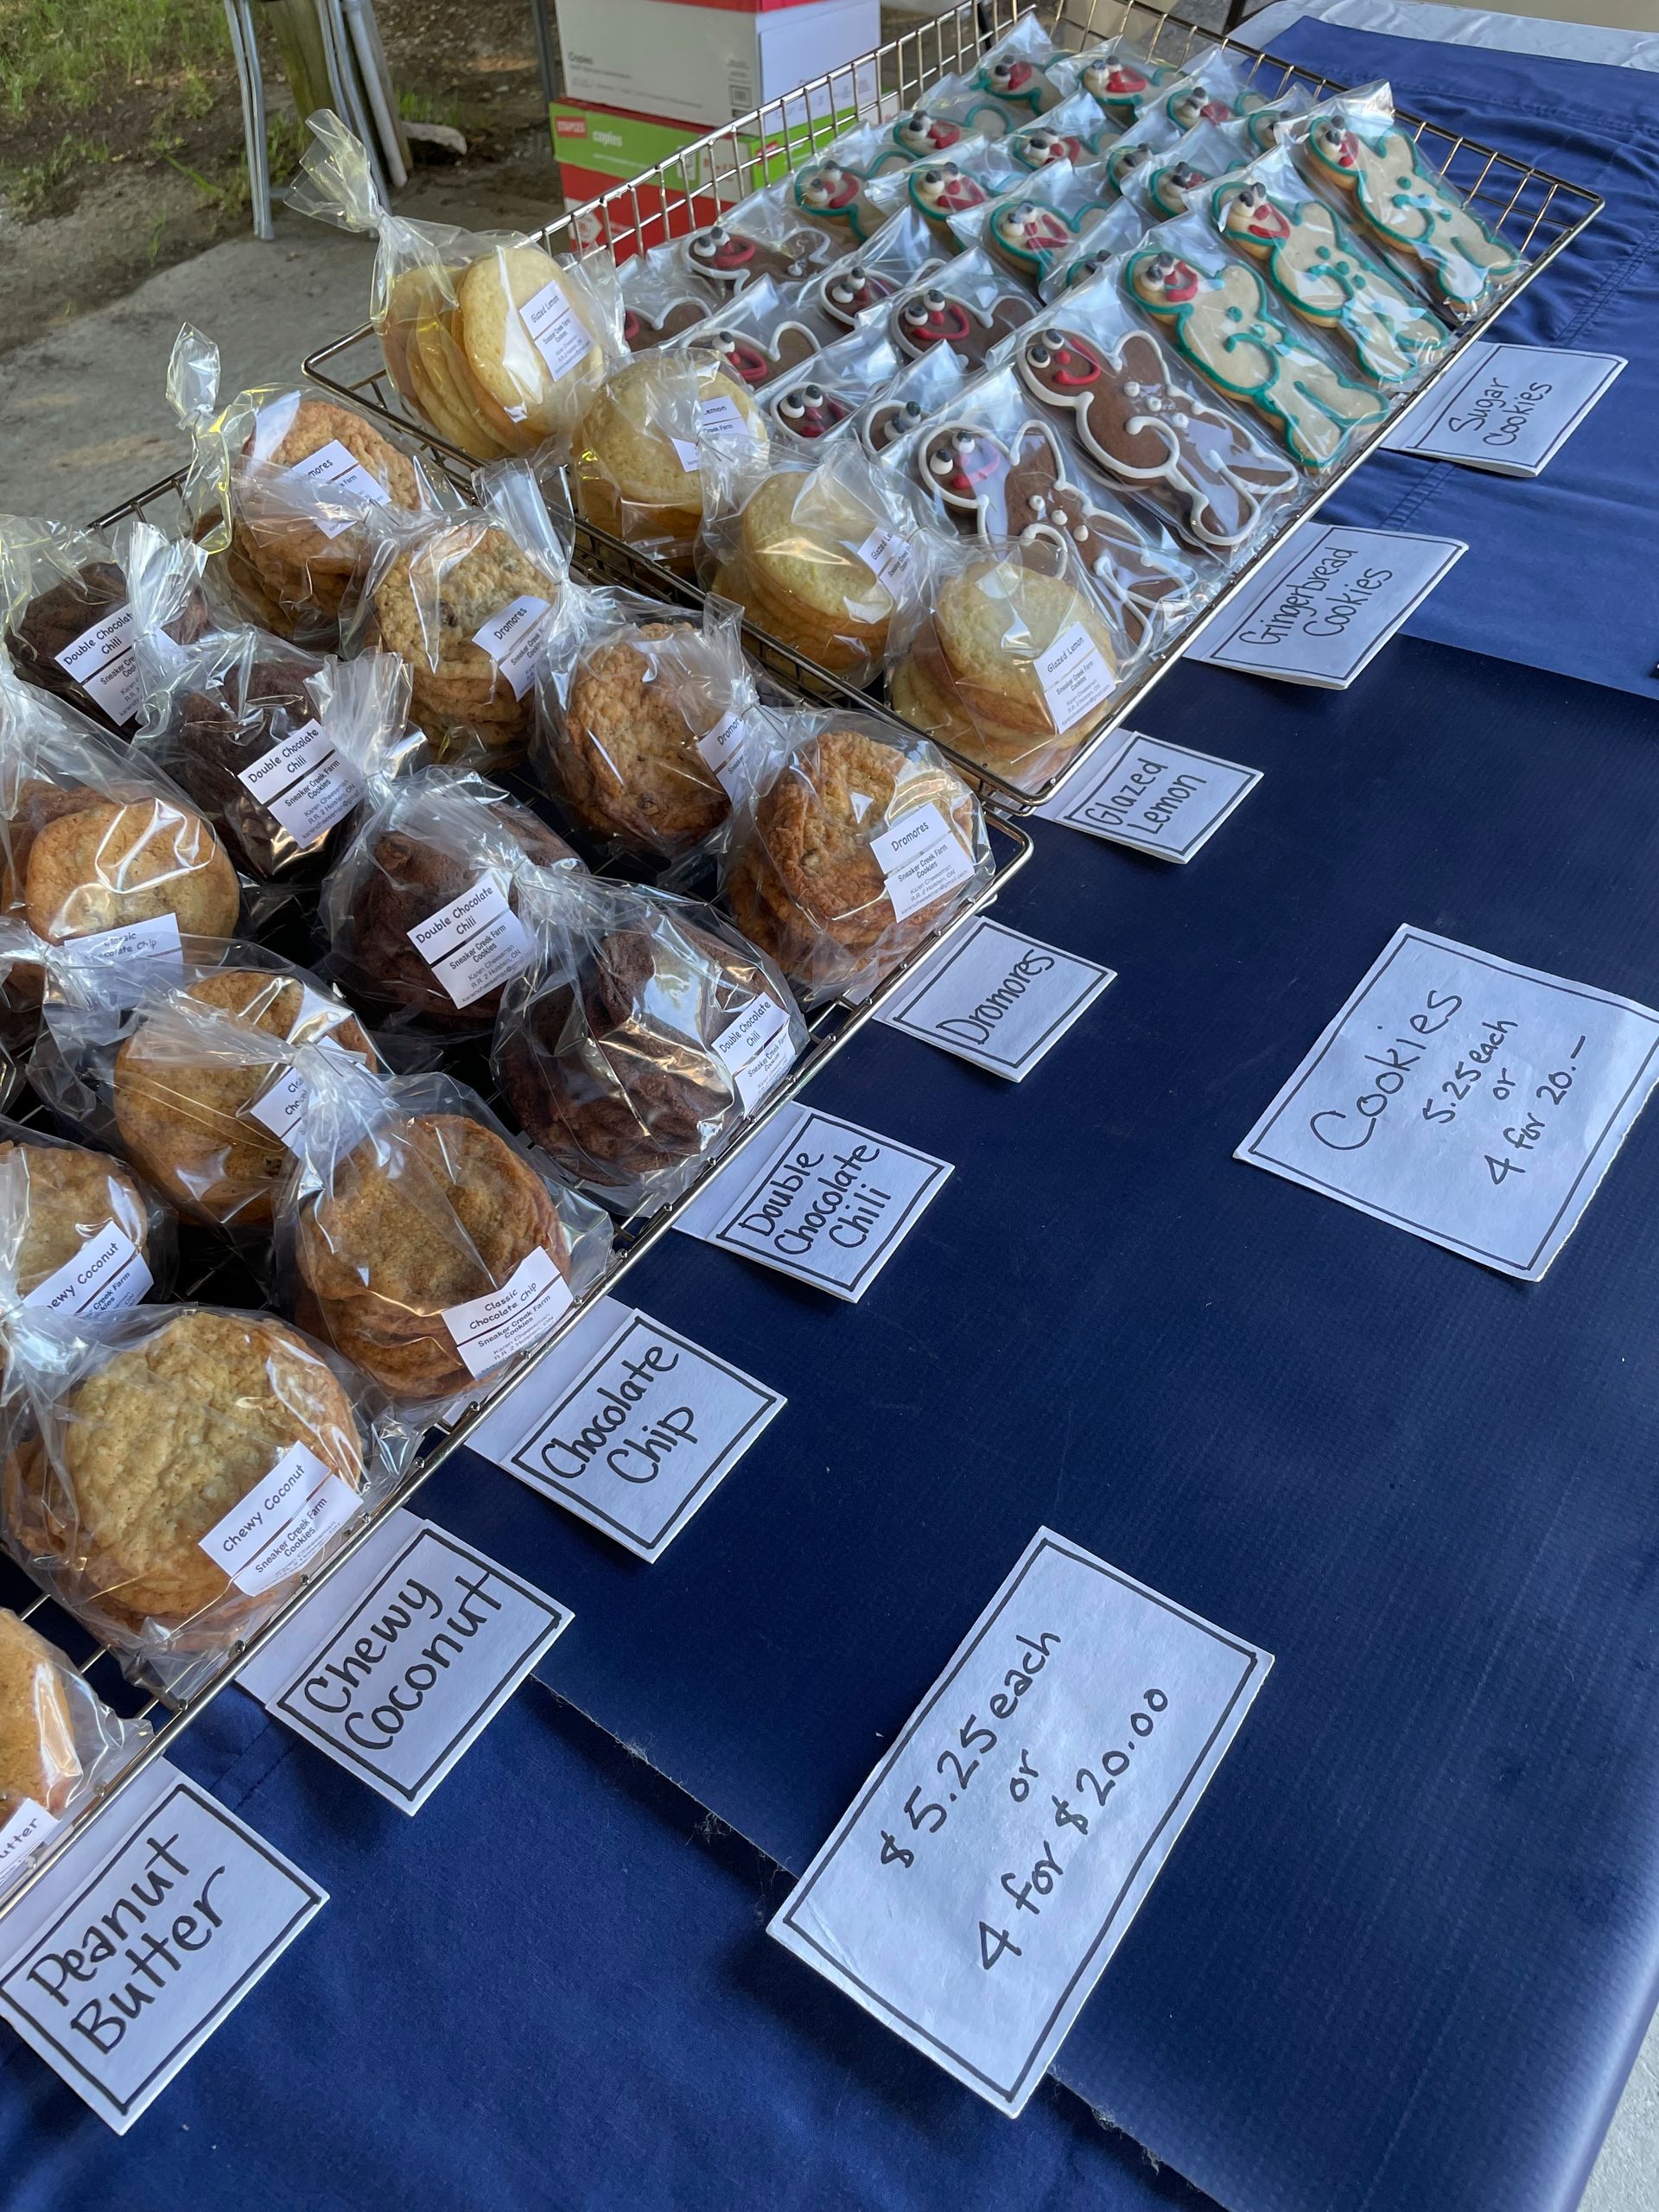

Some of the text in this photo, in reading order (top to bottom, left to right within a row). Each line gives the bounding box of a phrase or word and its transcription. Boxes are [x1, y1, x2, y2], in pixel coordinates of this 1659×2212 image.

[1448, 378, 1510, 432] Sugar
[1483, 382, 1553, 446] Cookies
[308, 460, 334, 478] mores
[1239, 547, 1358, 645] Gingerbread
[1303, 568, 1393, 636] Cookies
[63, 612, 133, 665] Double Chocolat
[101, 636, 123, 655] Chili
[493, 607, 527, 639] Dromores
[100, 664, 124, 684] Sneaker
[124, 657, 135, 666] Cre
[1047, 637, 1084, 672] Glazed Lemon
[248, 728, 319, 783] Double Chocolate
[287, 755, 308, 773] Chili
[285, 760, 340, 807] Sneaker Creek Farm
[308, 779, 332, 799] Cookies
[1084, 757, 1168, 825] Glazed
[1127, 774, 1207, 835] Lemon
[891, 822, 930, 851] Dromores
[898, 844, 948, 882] Sneaker Creek Farm
[916, 861, 938, 879] Cookies
[416, 887, 493, 944] Double Chocolate
[456, 915, 477, 935] Chili
[137, 938, 157, 949] Chip
[449, 925, 506, 969] Sneaker Creek Farm
[473, 942, 498, 963] Cookies
[512, 949, 521, 959] ON
[936, 949, 1055, 1046] Dromores
[719, 1001, 772, 1053] Double Chocolate
[747, 1030, 760, 1047] Chili
[1310, 989, 1462, 1150] Cookies
[1423, 1021, 1519, 1124] 5.25 each
[1492, 1067, 1516, 1101] or
[1503, 1112, 1545, 1149] for
[738, 1152, 824, 1236] Double
[1484, 1154, 1526, 1185] 4
[774, 1144, 880, 1254] Chocolate
[829, 1184, 892, 1248] Chili
[78, 1242, 118, 1285] Coconut
[93, 1289, 113, 1310] Creek
[112, 1273, 130, 1291] Farm
[469, 1282, 537, 1330] Chocolate Chip
[485, 1289, 518, 1312] Classic
[478, 1295, 551, 1348] Sneaker Creek Farm
[505, 1317, 534, 1339] Cookies
[541, 1346, 679, 1478] Chocolate
[607, 1407, 698, 1484] Chip
[223, 1510, 264, 1552] Chewy
[264, 1465, 305, 1510] Coconut
[256, 1497, 327, 1573] Sneaker Creek Farm
[284, 1527, 316, 1557] Cookies
[304, 1579, 443, 1713] Chewy
[345, 1571, 502, 1750] Coconut
[989, 1631, 1061, 1719] each
[1009, 1750, 1039, 1802] or
[0, 1817, 37, 1859] utter
[27, 1834, 190, 2007] Peanut
[979, 1921, 1021, 1971] 4
[1001, 1840, 1065, 1914] for
[70, 1866, 226, 2055] Butter
